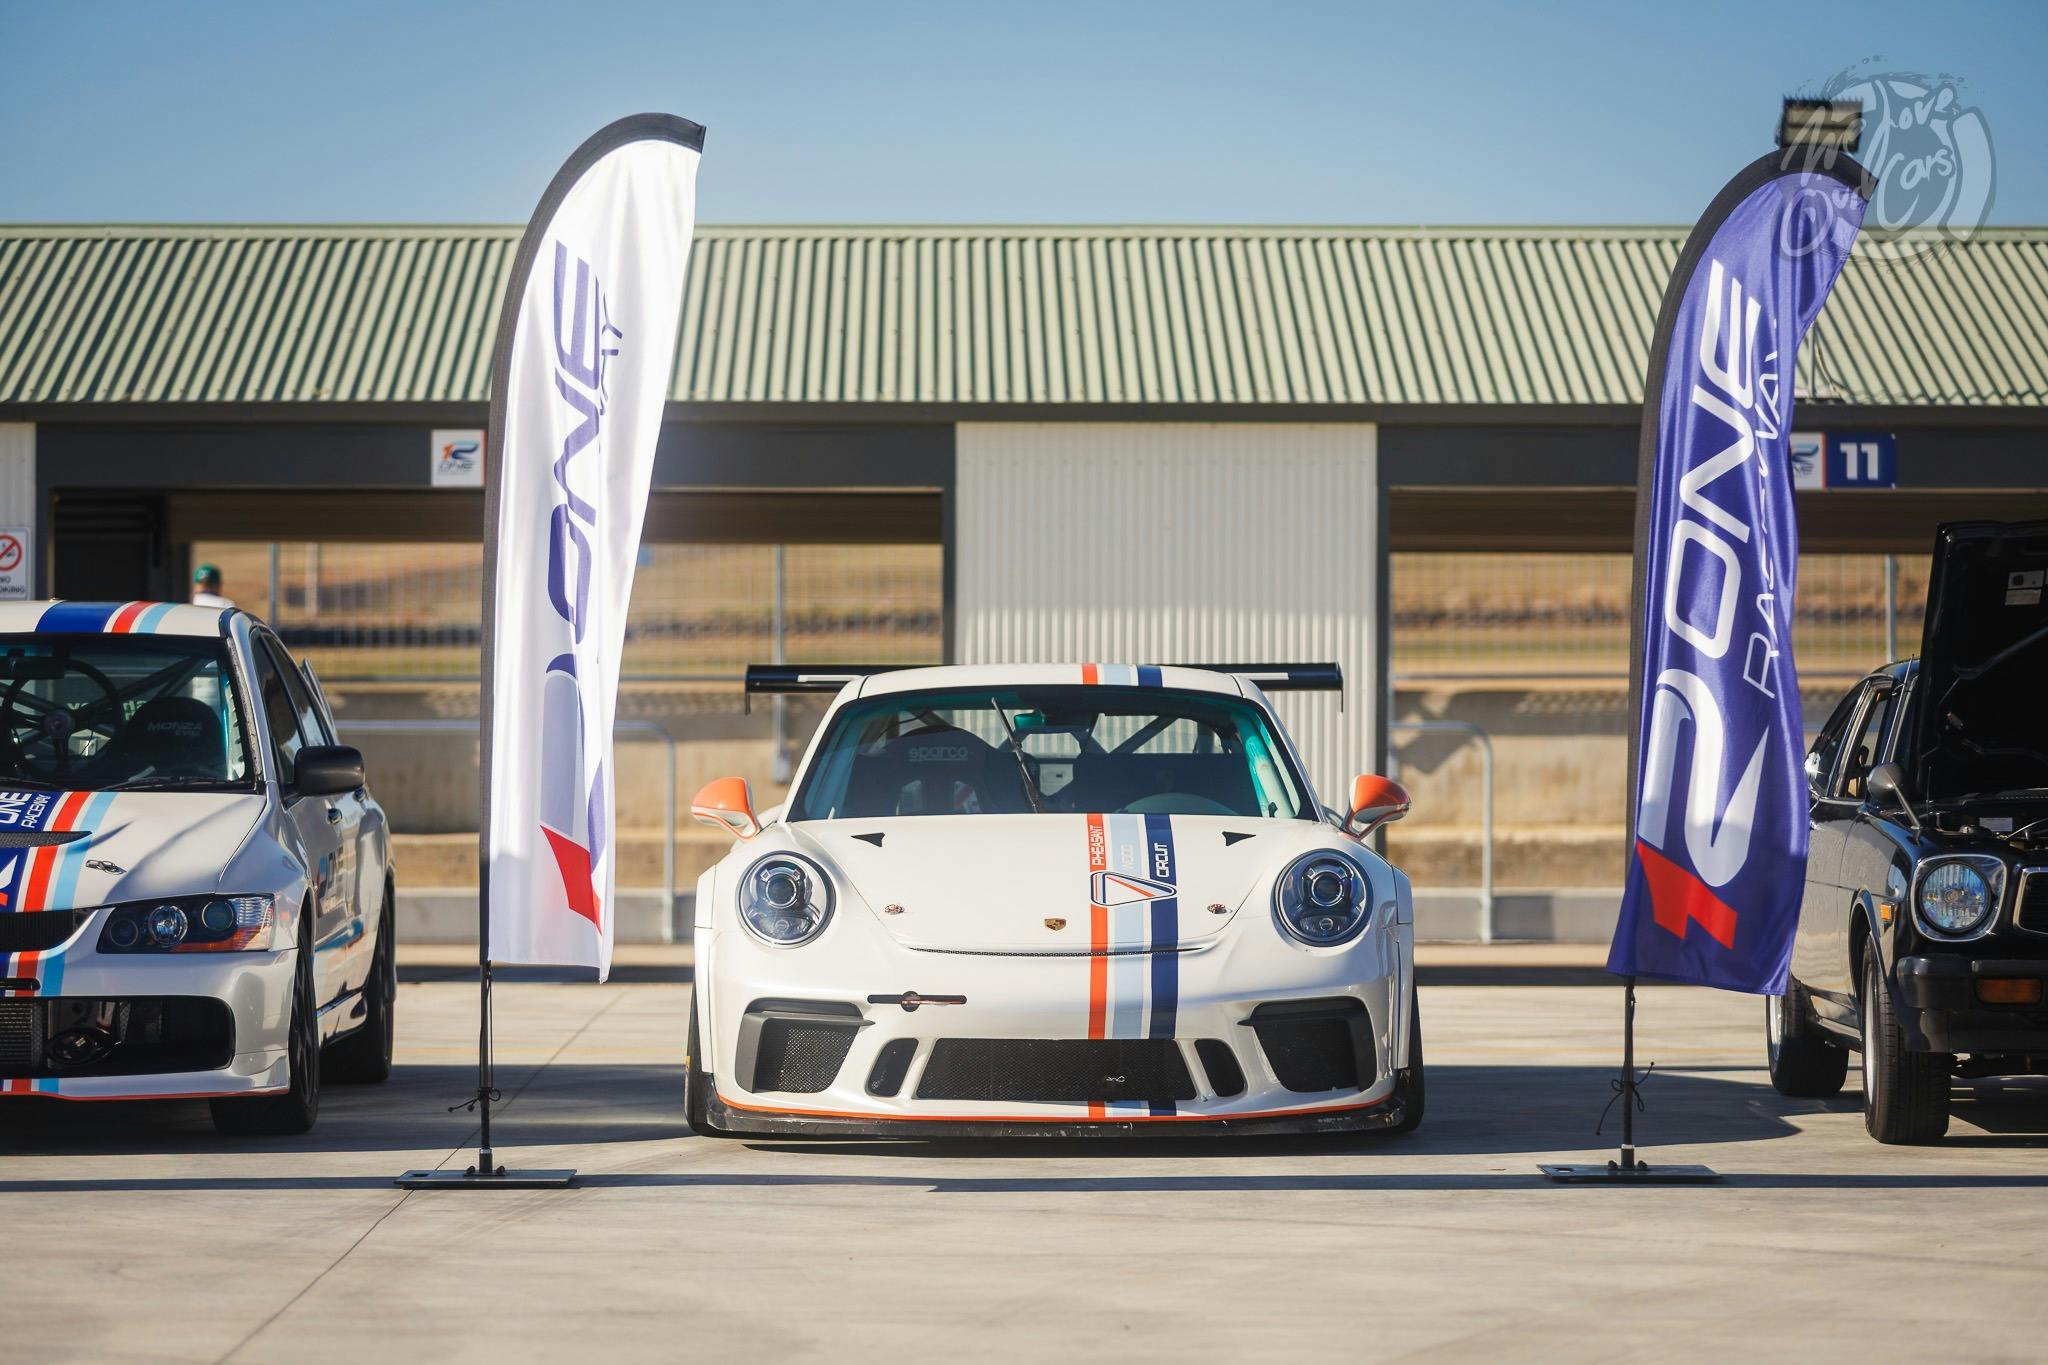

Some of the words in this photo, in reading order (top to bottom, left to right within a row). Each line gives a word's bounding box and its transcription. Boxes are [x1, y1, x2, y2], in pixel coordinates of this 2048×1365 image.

[1664, 258, 1761, 659] ONE
[1840, 442, 1879, 480] 11
[909, 746, 969, 761] sparco
[21, 794, 51, 829] RACEWAY
[1089, 824, 1105, 866] PHEASANT
[1154, 842, 1170, 878] CIRCUIT
